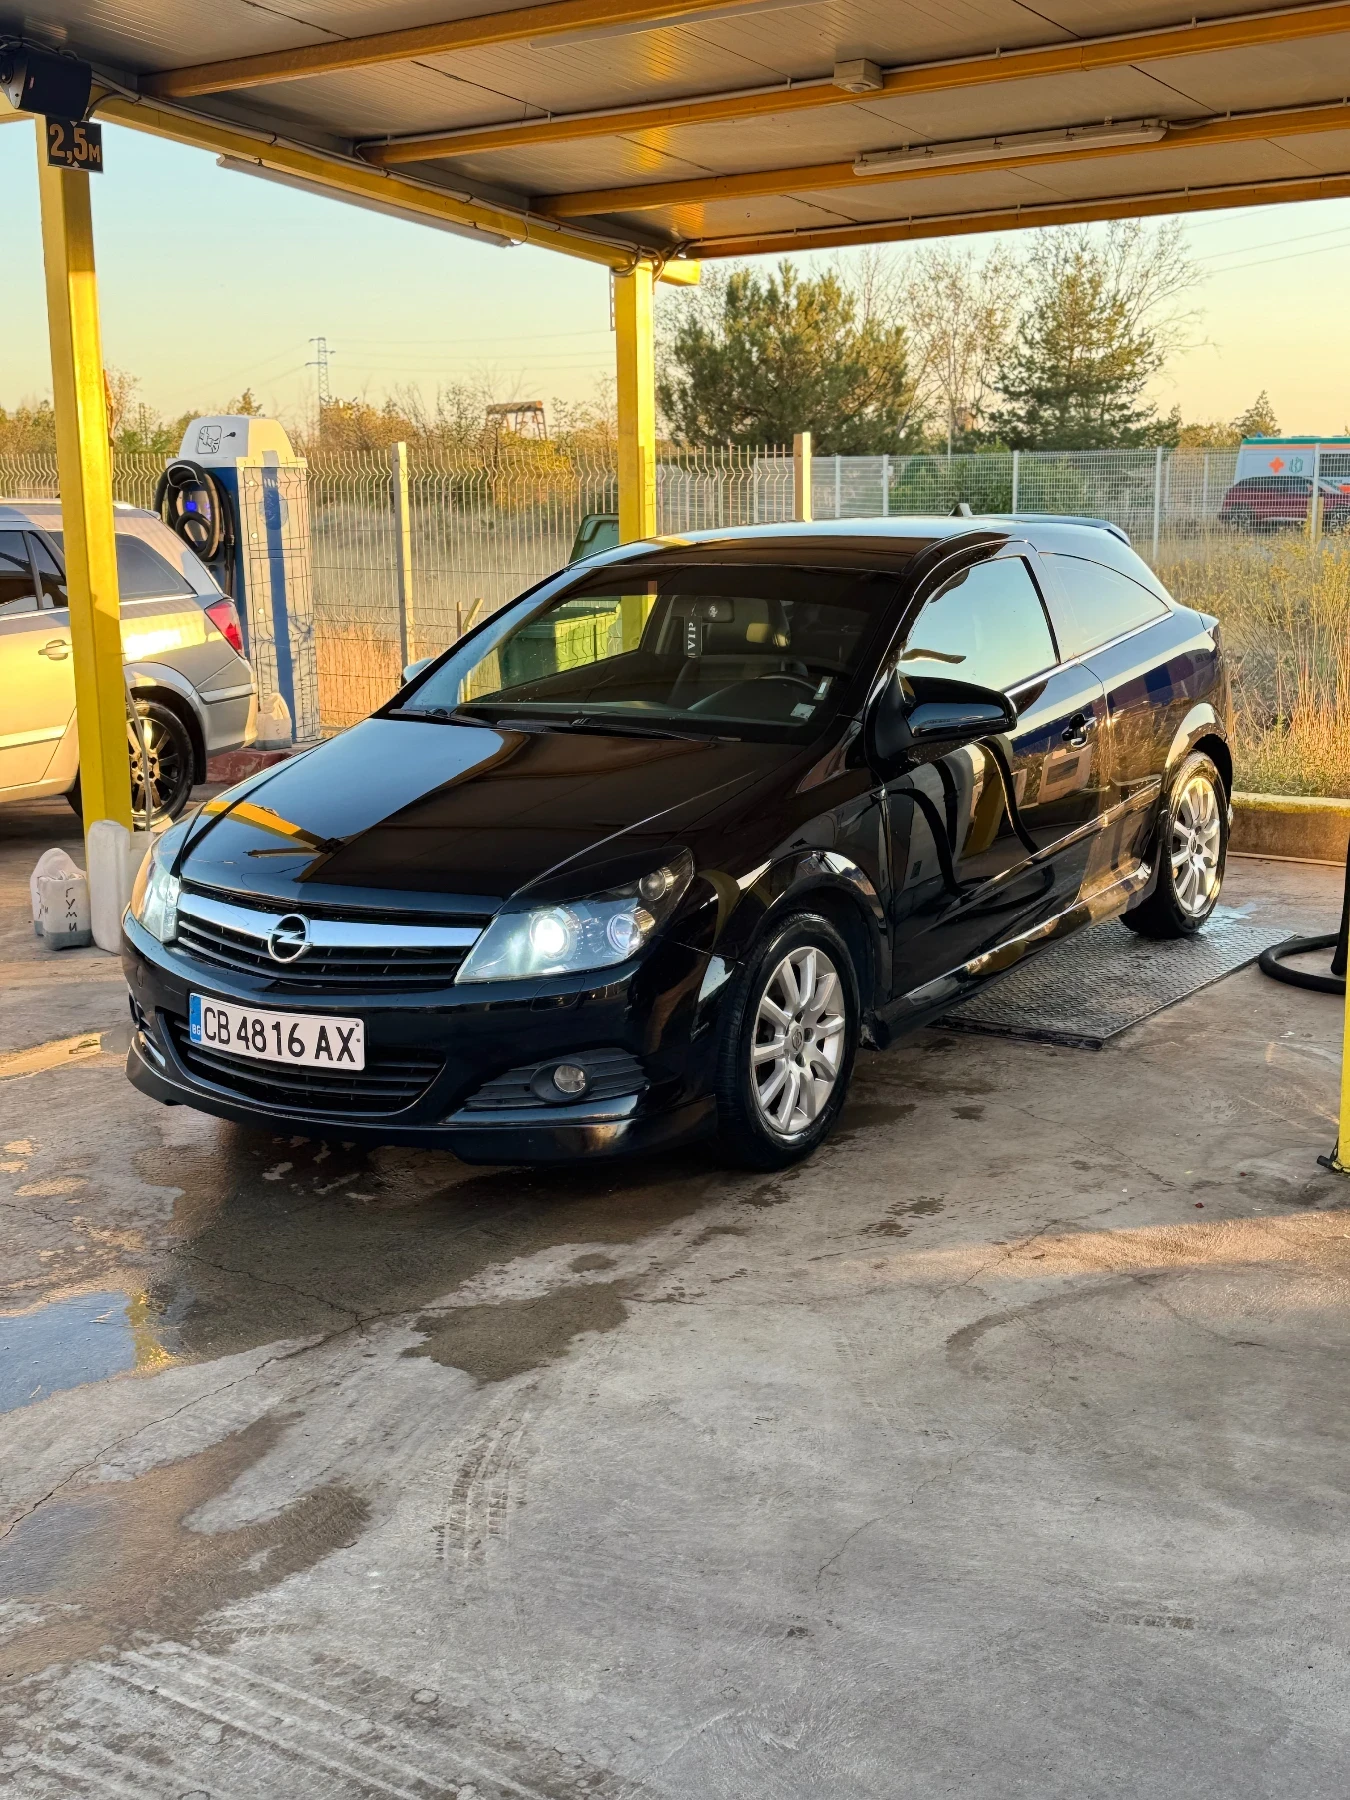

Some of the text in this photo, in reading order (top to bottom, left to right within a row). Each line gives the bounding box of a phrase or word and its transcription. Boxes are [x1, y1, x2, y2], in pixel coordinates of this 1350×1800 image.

[687, 621, 696, 650] VIP
[191, 1023, 201, 1035] BG
[203, 1006, 356, 1063] CB 4816 AX
